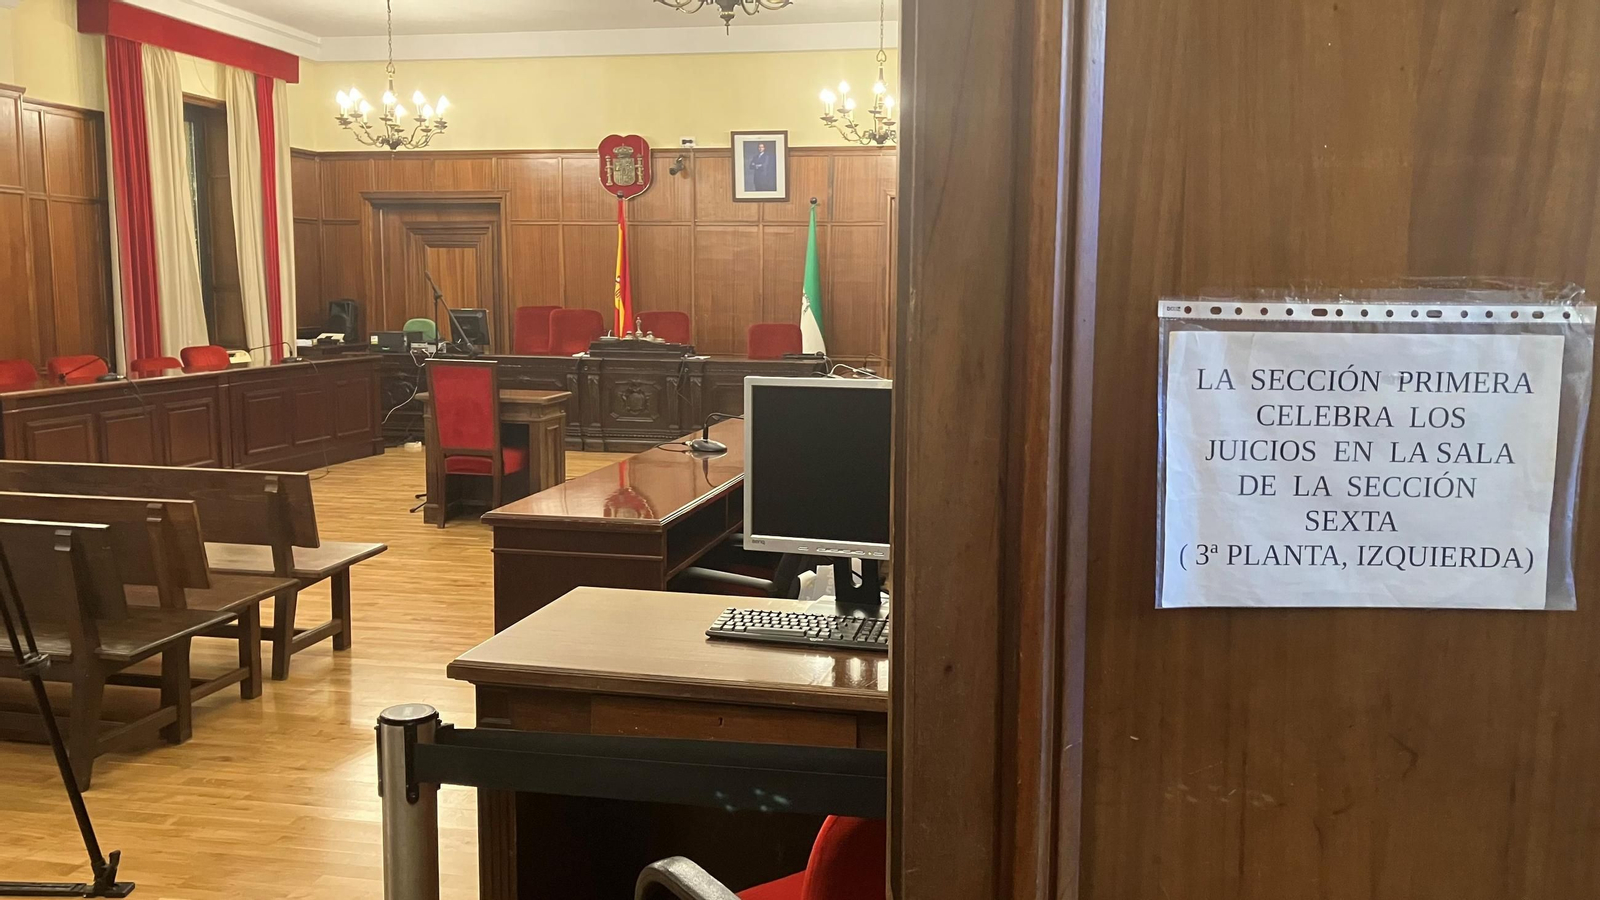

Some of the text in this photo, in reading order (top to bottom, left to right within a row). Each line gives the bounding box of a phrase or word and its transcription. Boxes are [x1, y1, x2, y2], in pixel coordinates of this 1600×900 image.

[1196, 363, 1535, 394] LA SECCIÓN PRIMERA
[1256, 404, 1466, 429] CELEBRA LOS
[1204, 439, 1516, 465] JUICIOS EN LA SALA
[1237, 470, 1478, 499] DE LA SECCIÓN
[1305, 509, 1399, 533] SEXTA
[1226, 544, 1347, 571] PLANTA,
[1356, 545, 1534, 575] IZQUIERDA)
